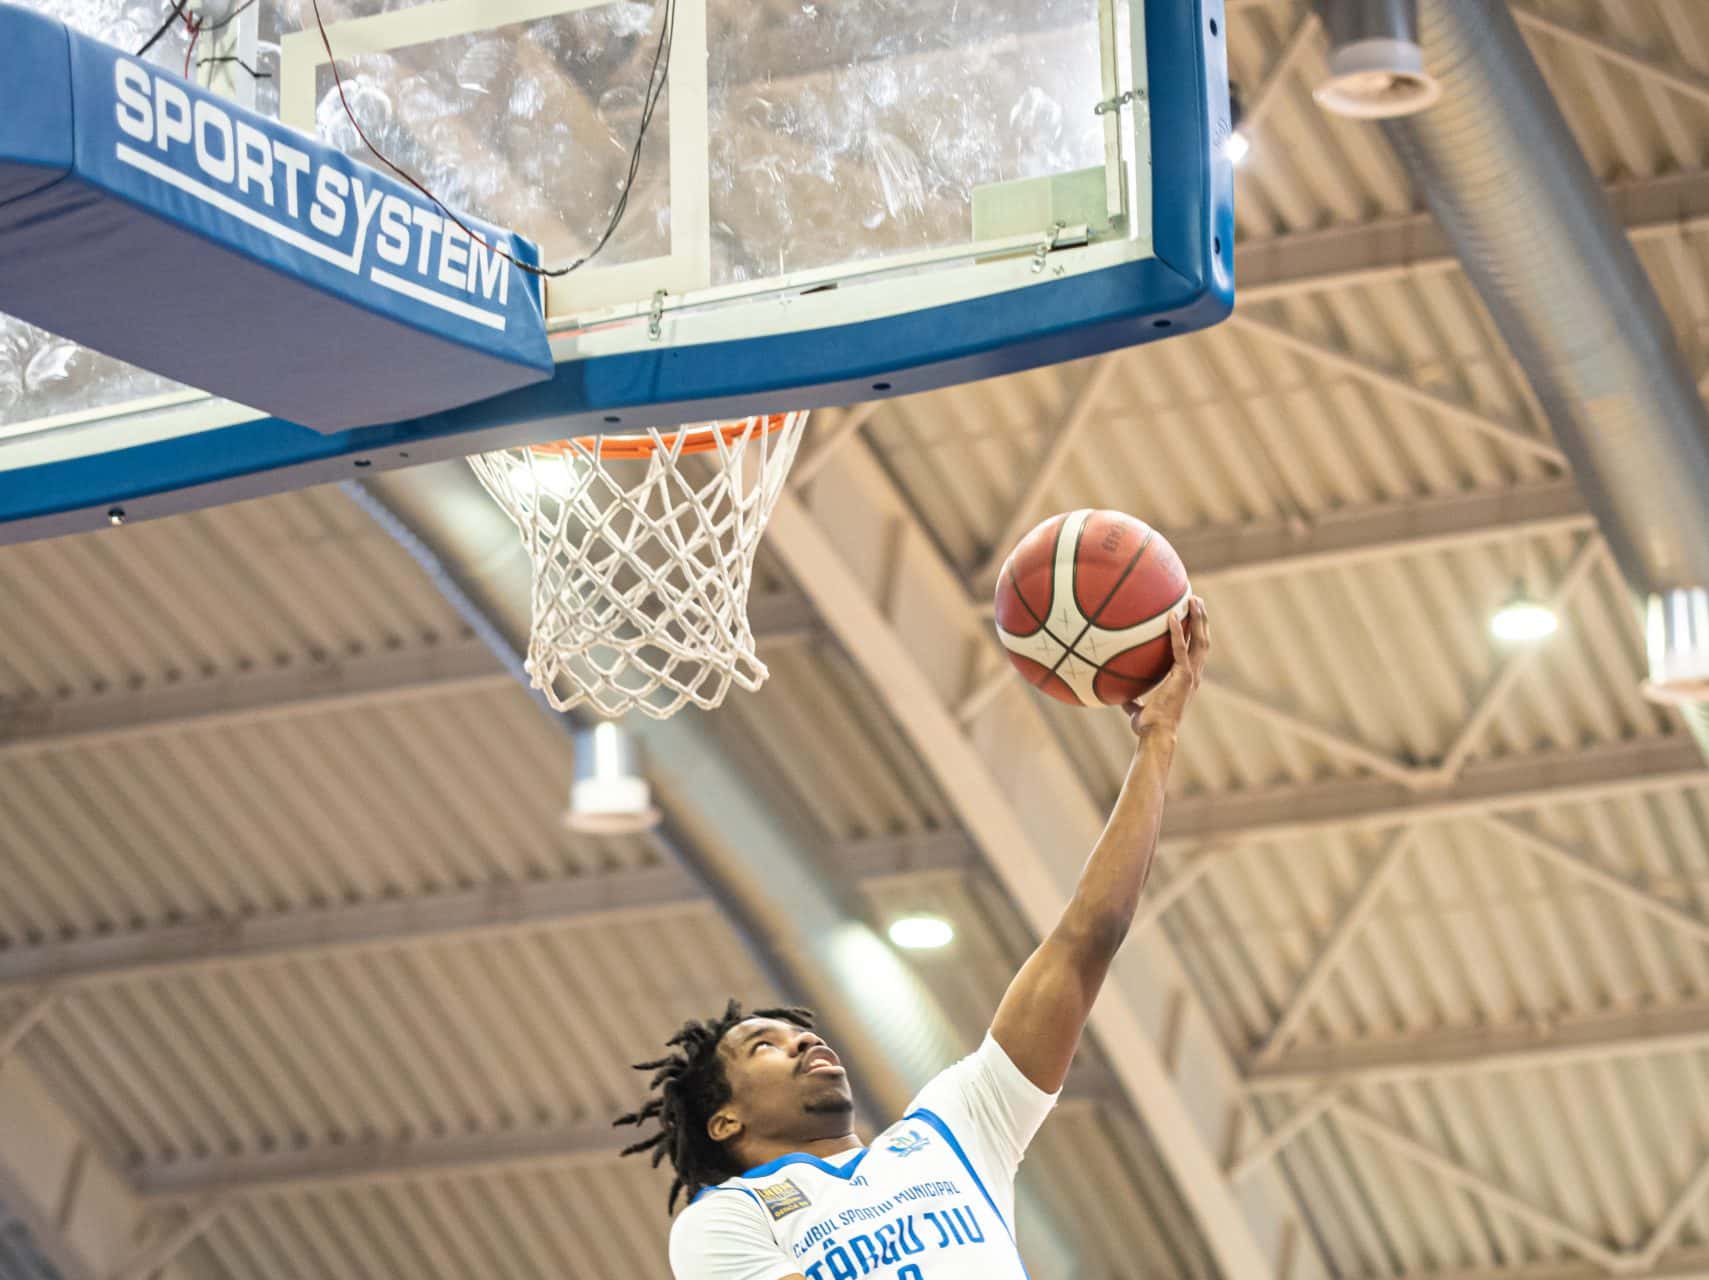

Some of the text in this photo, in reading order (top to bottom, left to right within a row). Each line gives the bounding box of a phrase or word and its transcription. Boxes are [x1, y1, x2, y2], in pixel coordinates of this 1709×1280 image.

[792, 1218, 841, 1260] CLUBUL
[893, 1179, 961, 1205] MUNICIPAL
[922, 1203, 986, 1249] JIU
